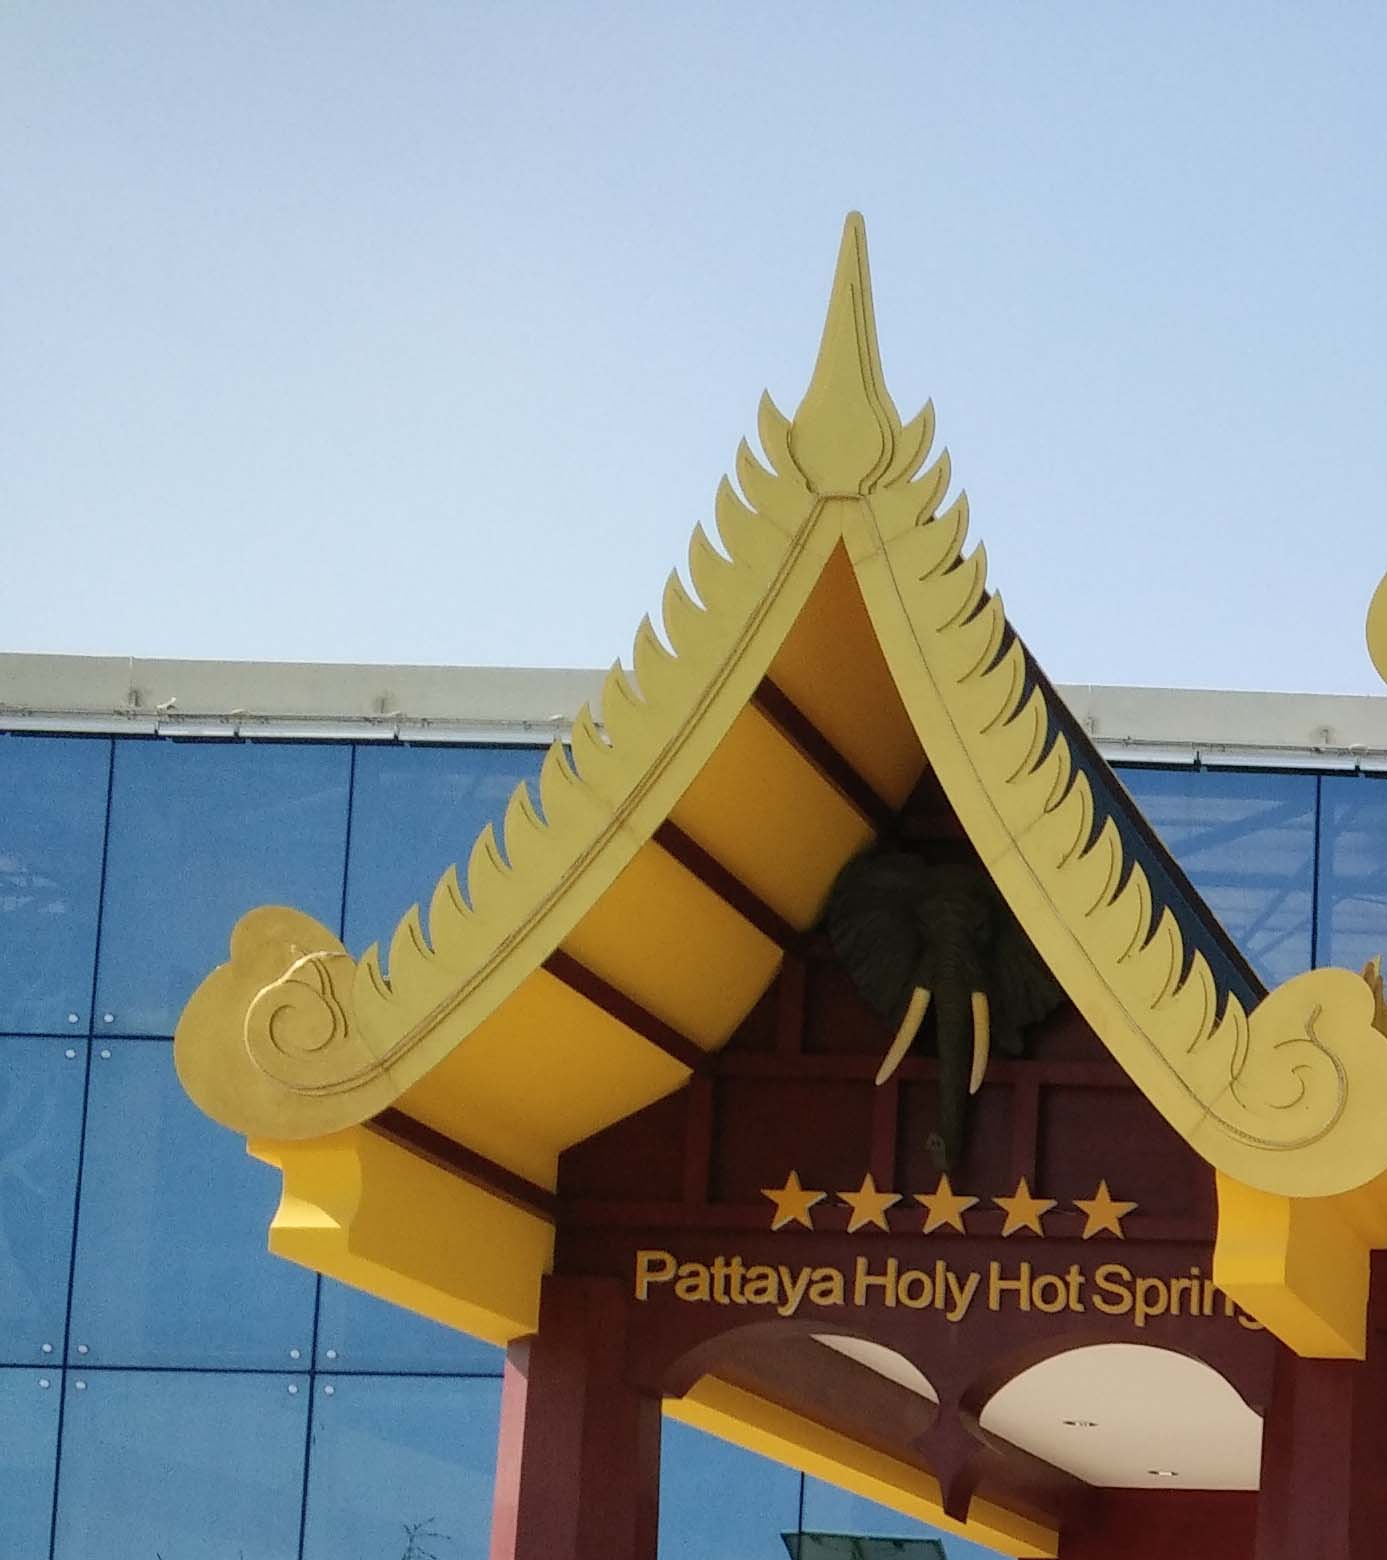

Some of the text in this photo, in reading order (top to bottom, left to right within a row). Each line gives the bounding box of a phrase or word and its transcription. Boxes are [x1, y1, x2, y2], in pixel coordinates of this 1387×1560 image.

[634, 1249, 1265, 1330] Pattaya Holy Hot Sprin
